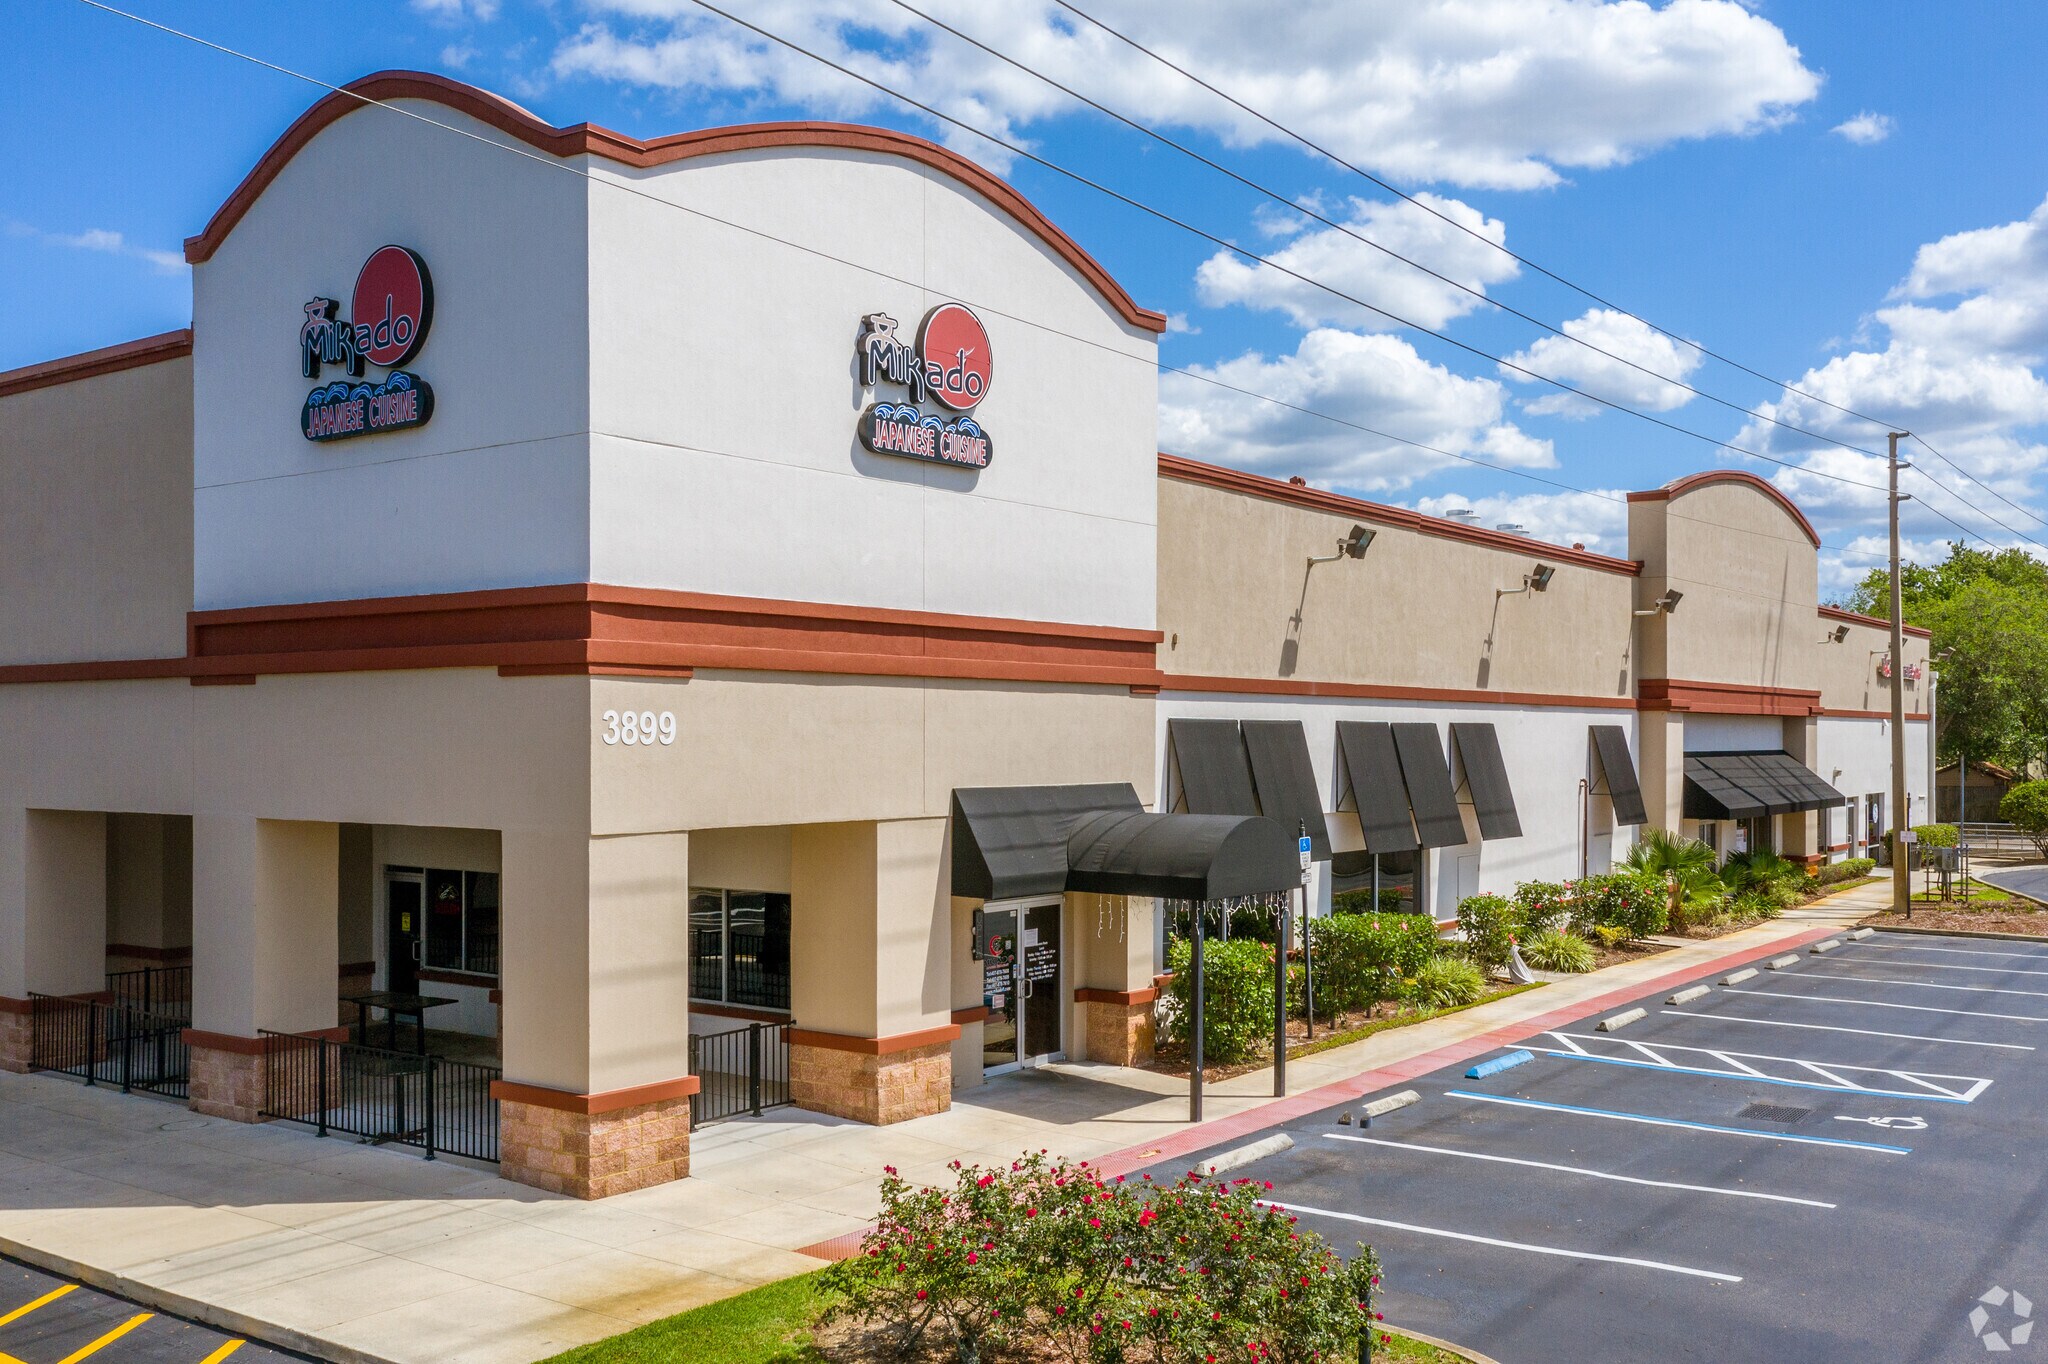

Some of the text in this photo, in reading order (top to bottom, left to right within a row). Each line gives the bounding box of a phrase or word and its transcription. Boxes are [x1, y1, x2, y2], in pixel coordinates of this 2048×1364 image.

[302, 294, 414, 377] Mikado
[868, 339, 983, 403] Mikado
[307, 389, 417, 438] JAPANESE CUISINE
[873, 418, 987, 466] JAPANESE CUISINE
[602, 710, 677, 746] 3899
